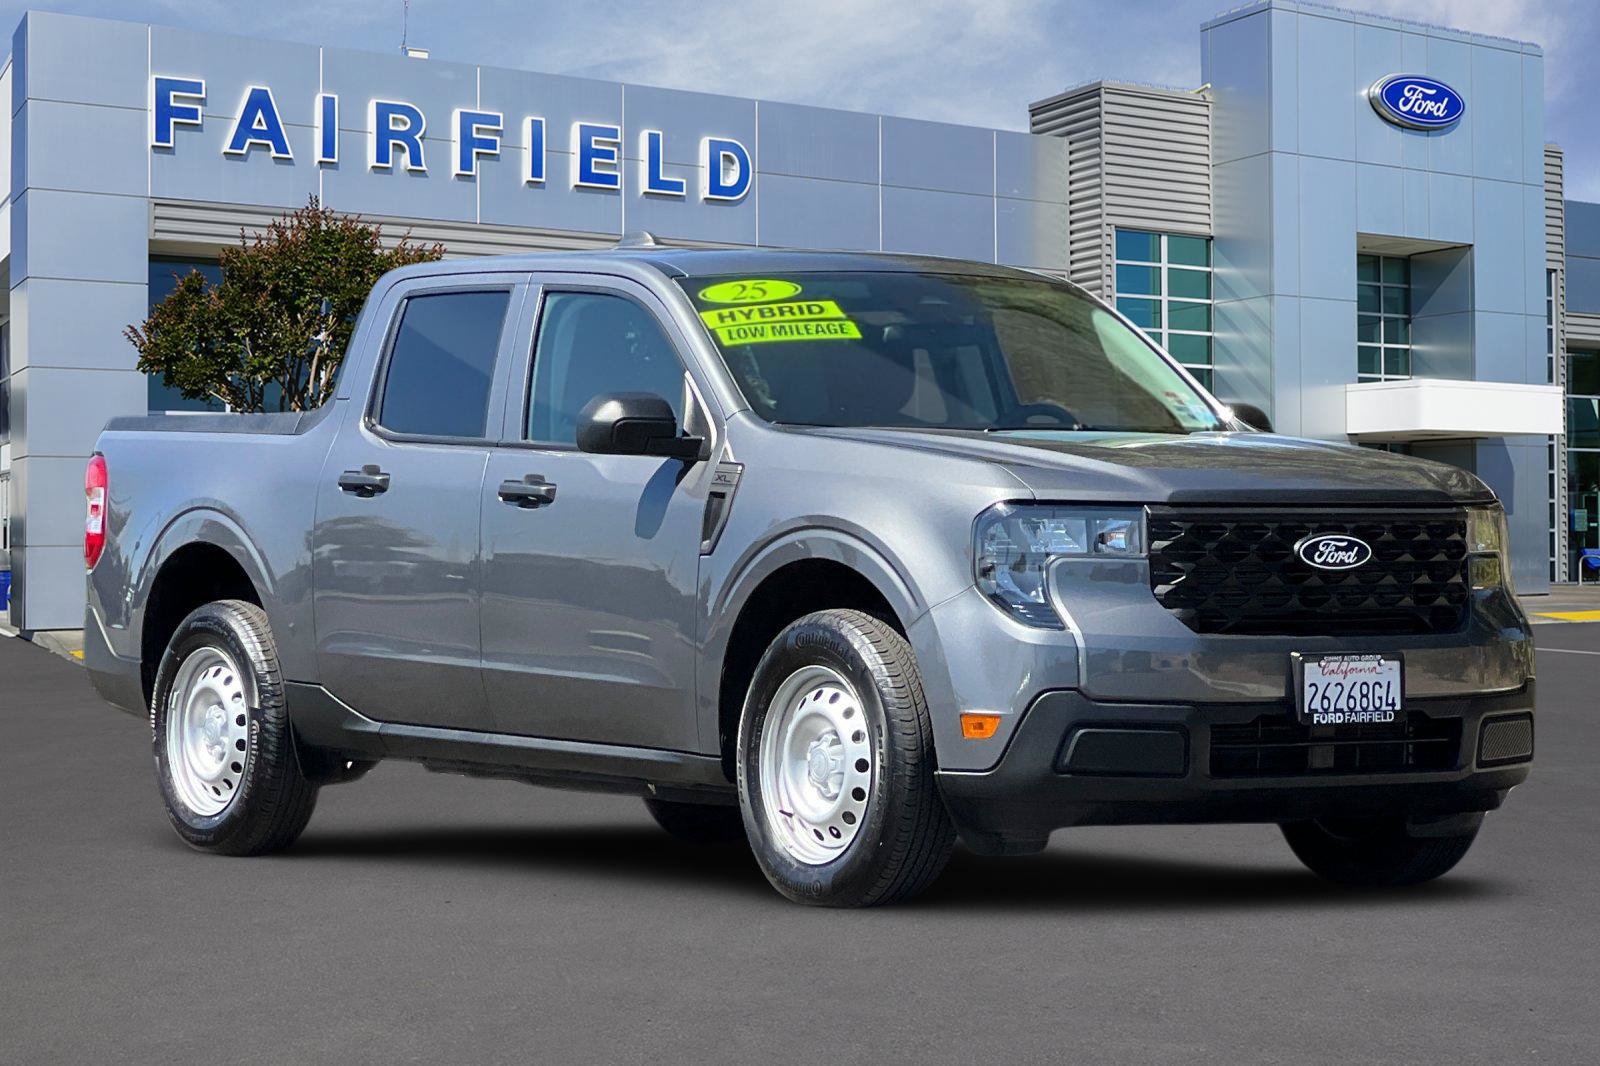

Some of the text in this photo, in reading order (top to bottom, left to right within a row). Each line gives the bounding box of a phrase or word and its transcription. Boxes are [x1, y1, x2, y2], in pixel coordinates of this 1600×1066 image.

[1398, 84, 1449, 117] Ford
[150, 74, 753, 202] FAIRFIELD
[730, 281, 768, 300] 25
[717, 303, 825, 324] HYBRID
[727, 322, 849, 341] LOW MILEAGE
[715, 474, 731, 483] XL
[1314, 540, 1358, 563] Ford
[1322, 657, 1383, 680] California
[1308, 681, 1396, 712] 26268G4
[1313, 711, 1395, 724] FORD FAIRFIELD
